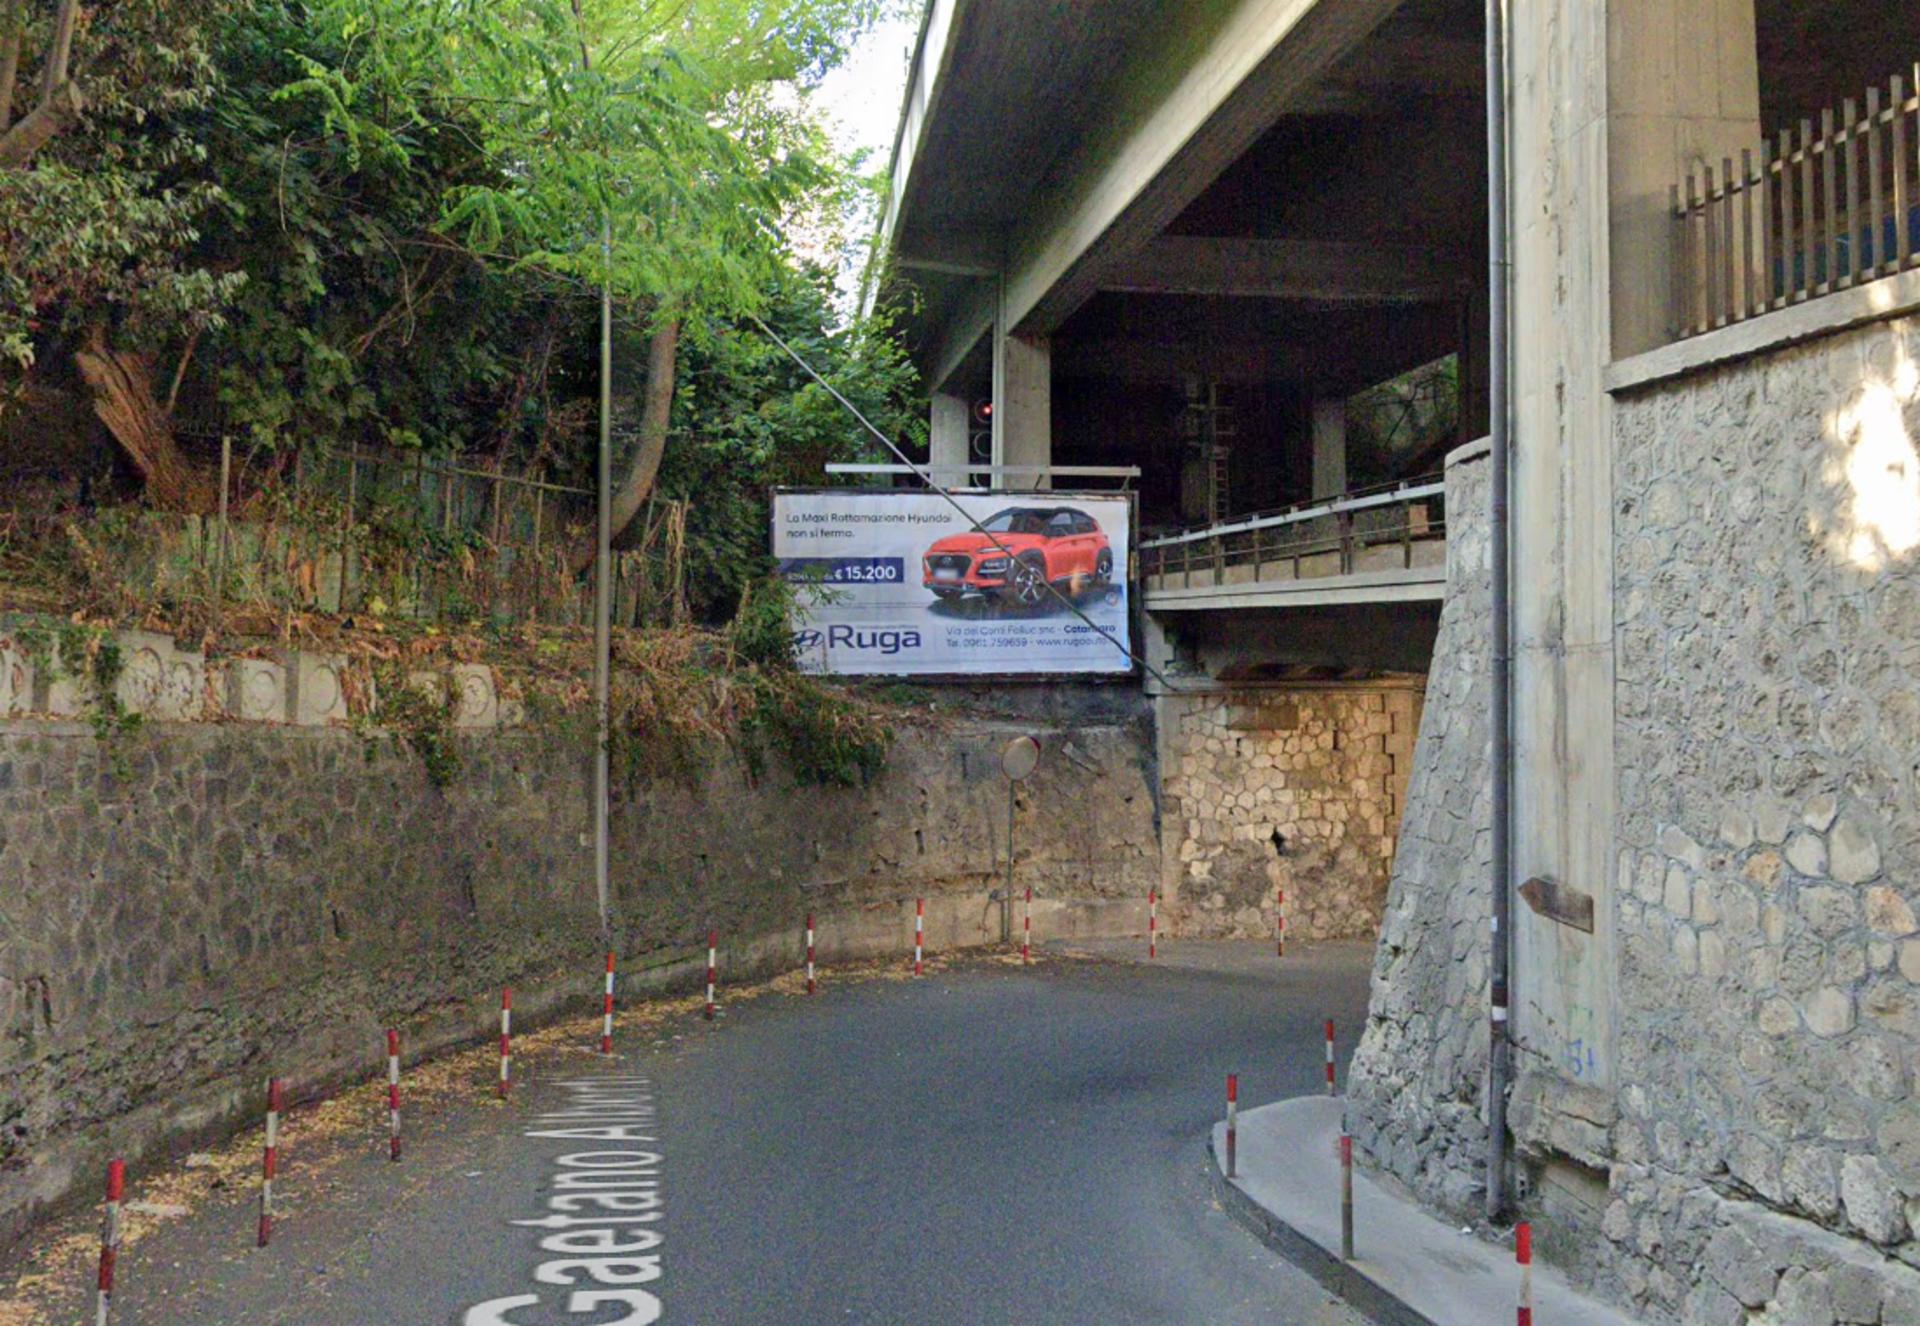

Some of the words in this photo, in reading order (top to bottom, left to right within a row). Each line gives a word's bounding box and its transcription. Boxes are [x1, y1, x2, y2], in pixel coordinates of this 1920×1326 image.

[802, 513, 828, 523] Maxi
[831, 513, 905, 523] Rottamazione
[907, 513, 952, 525] Hyundai
[786, 529, 807, 538] non
[845, 565, 896, 580] 15.200
[828, 624, 921, 654] Ruga
